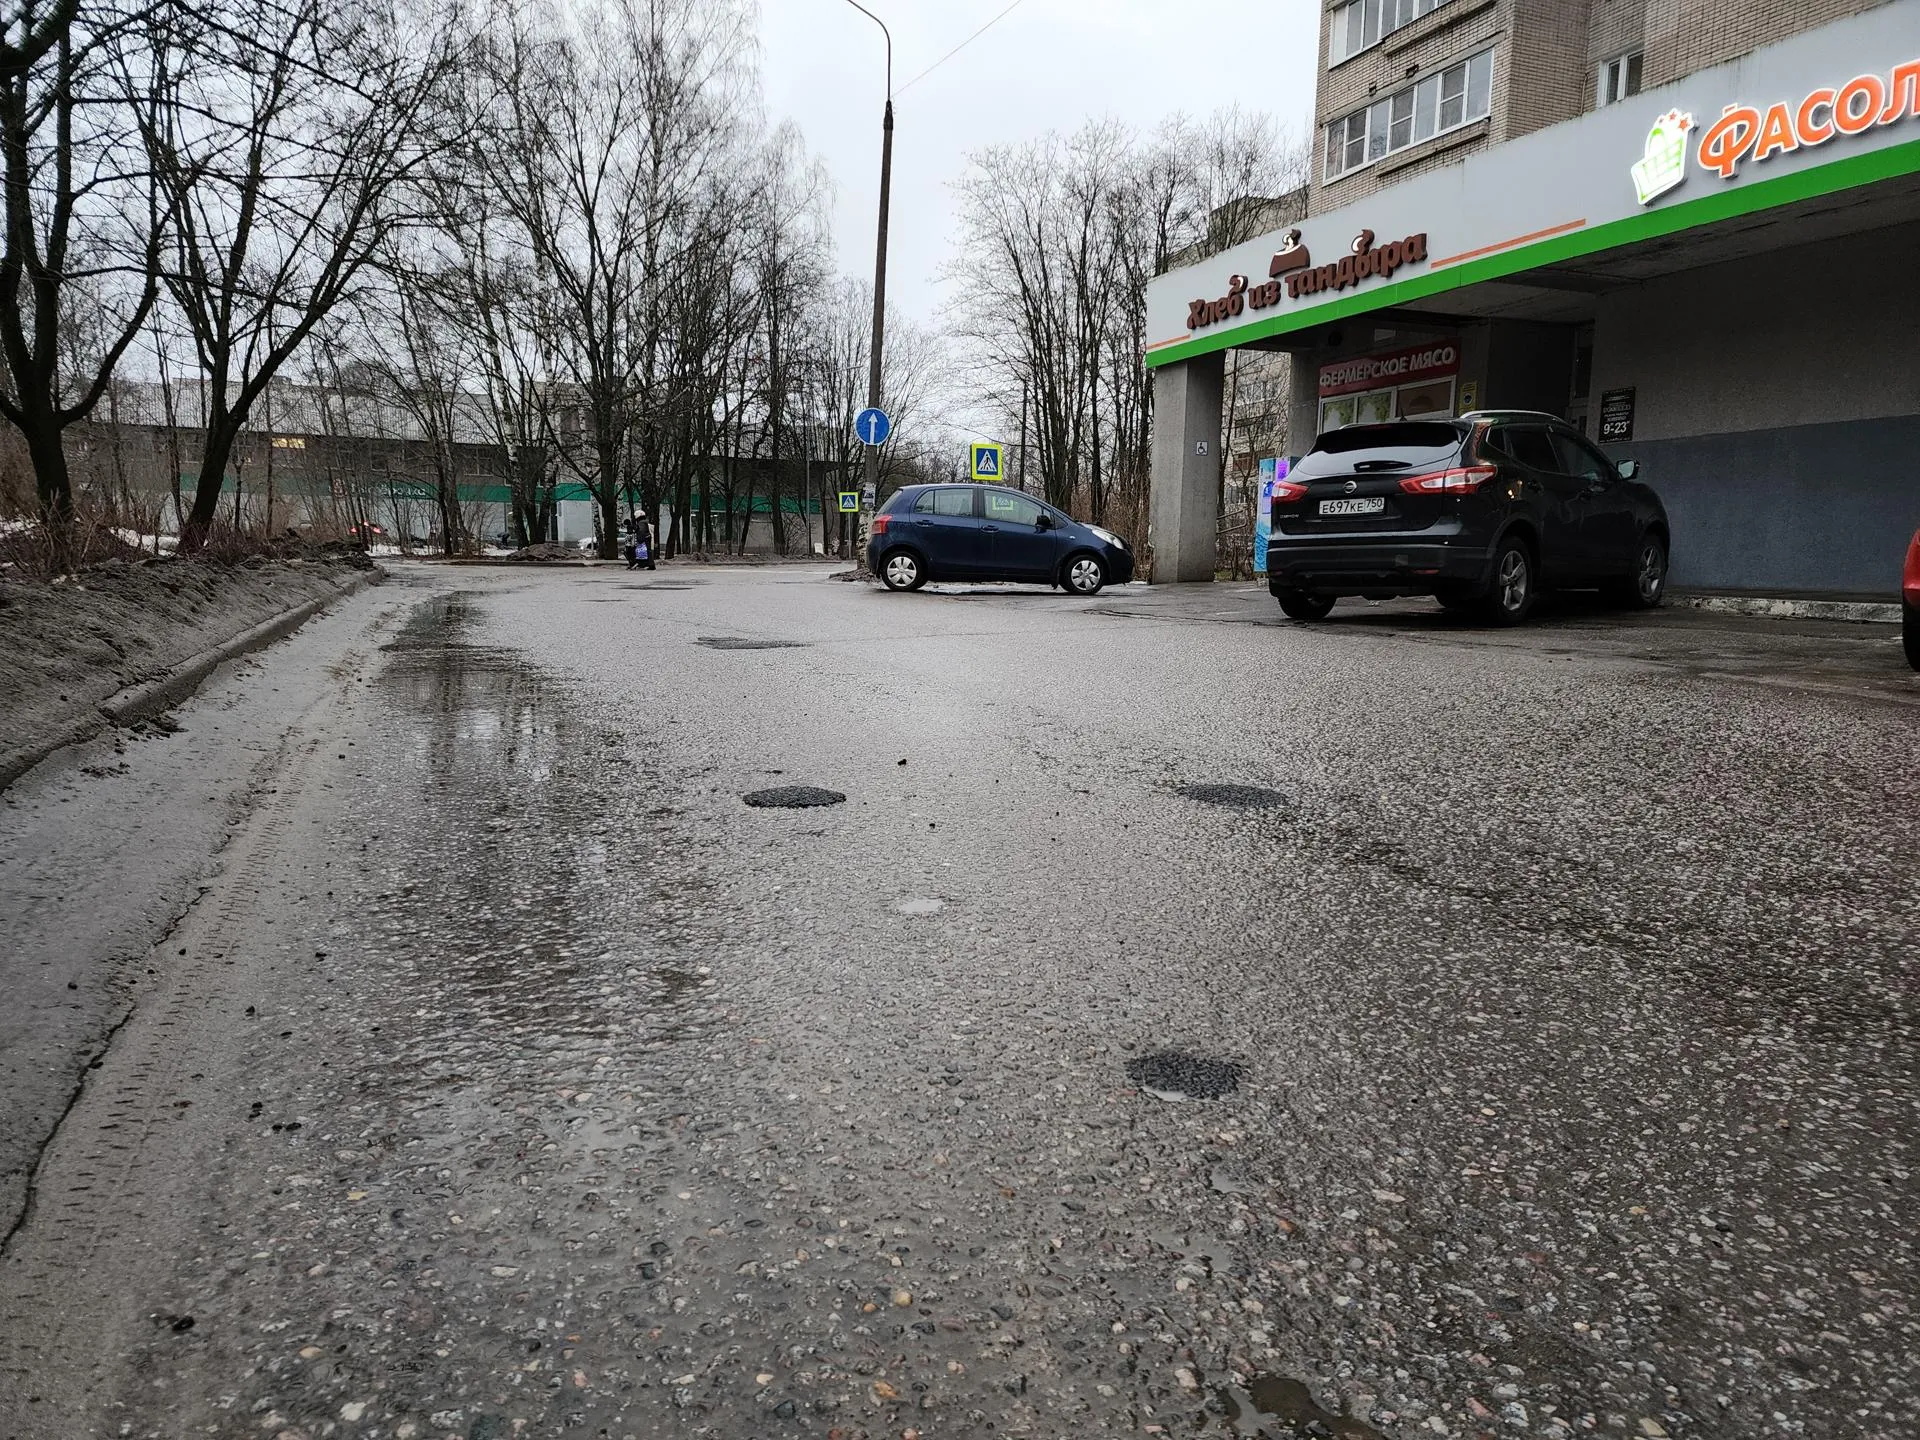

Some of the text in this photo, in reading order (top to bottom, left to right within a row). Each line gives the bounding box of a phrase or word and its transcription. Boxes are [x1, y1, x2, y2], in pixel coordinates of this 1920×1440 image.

[1187, 229, 1427, 329] Хлеб из тандыра
[1319, 346, 1457, 388] ФЕРМЕРСКОЕ МЯСО
